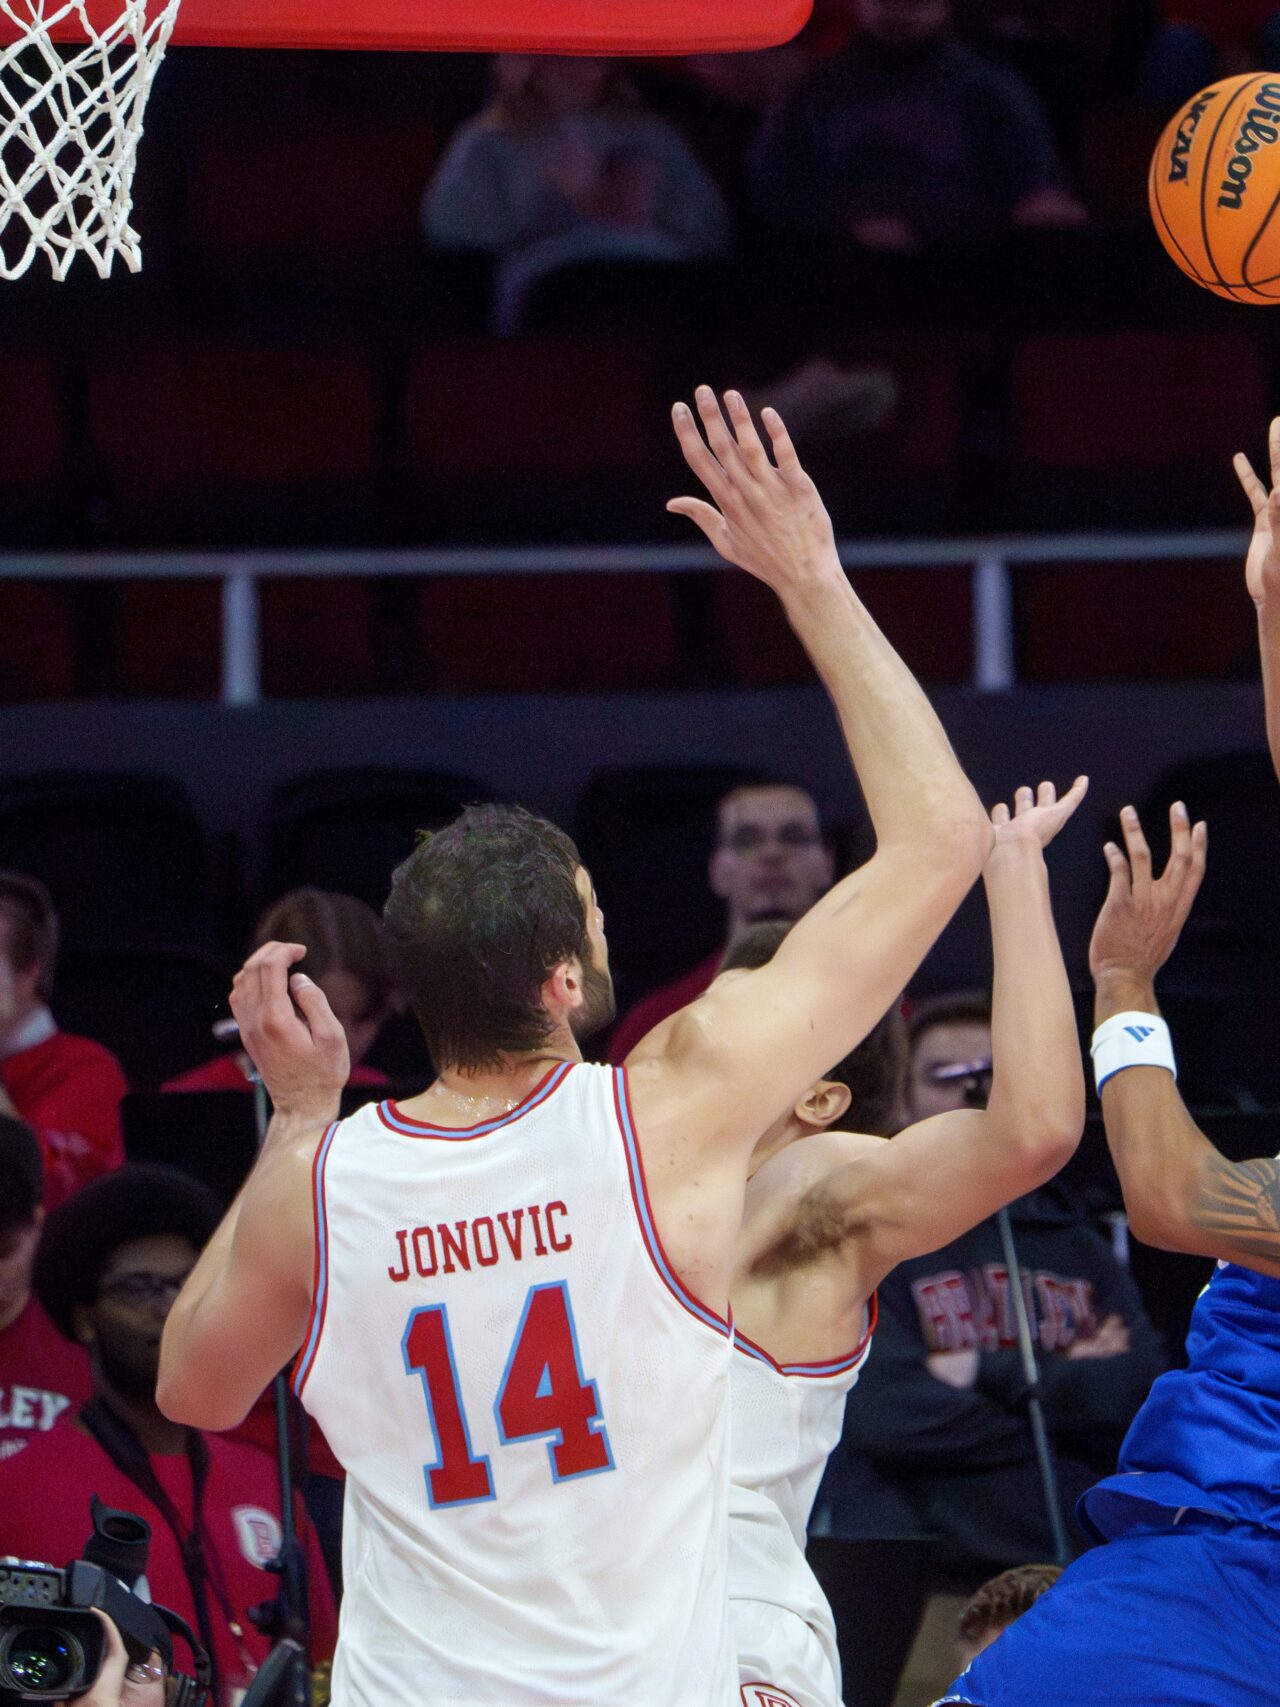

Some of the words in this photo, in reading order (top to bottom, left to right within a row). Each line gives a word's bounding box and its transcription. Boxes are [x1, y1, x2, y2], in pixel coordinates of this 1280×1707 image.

[1168, 91, 1220, 184] NCAA
[388, 1200, 573, 1283] JONOVIC
[400, 1279, 617, 1511] 14
